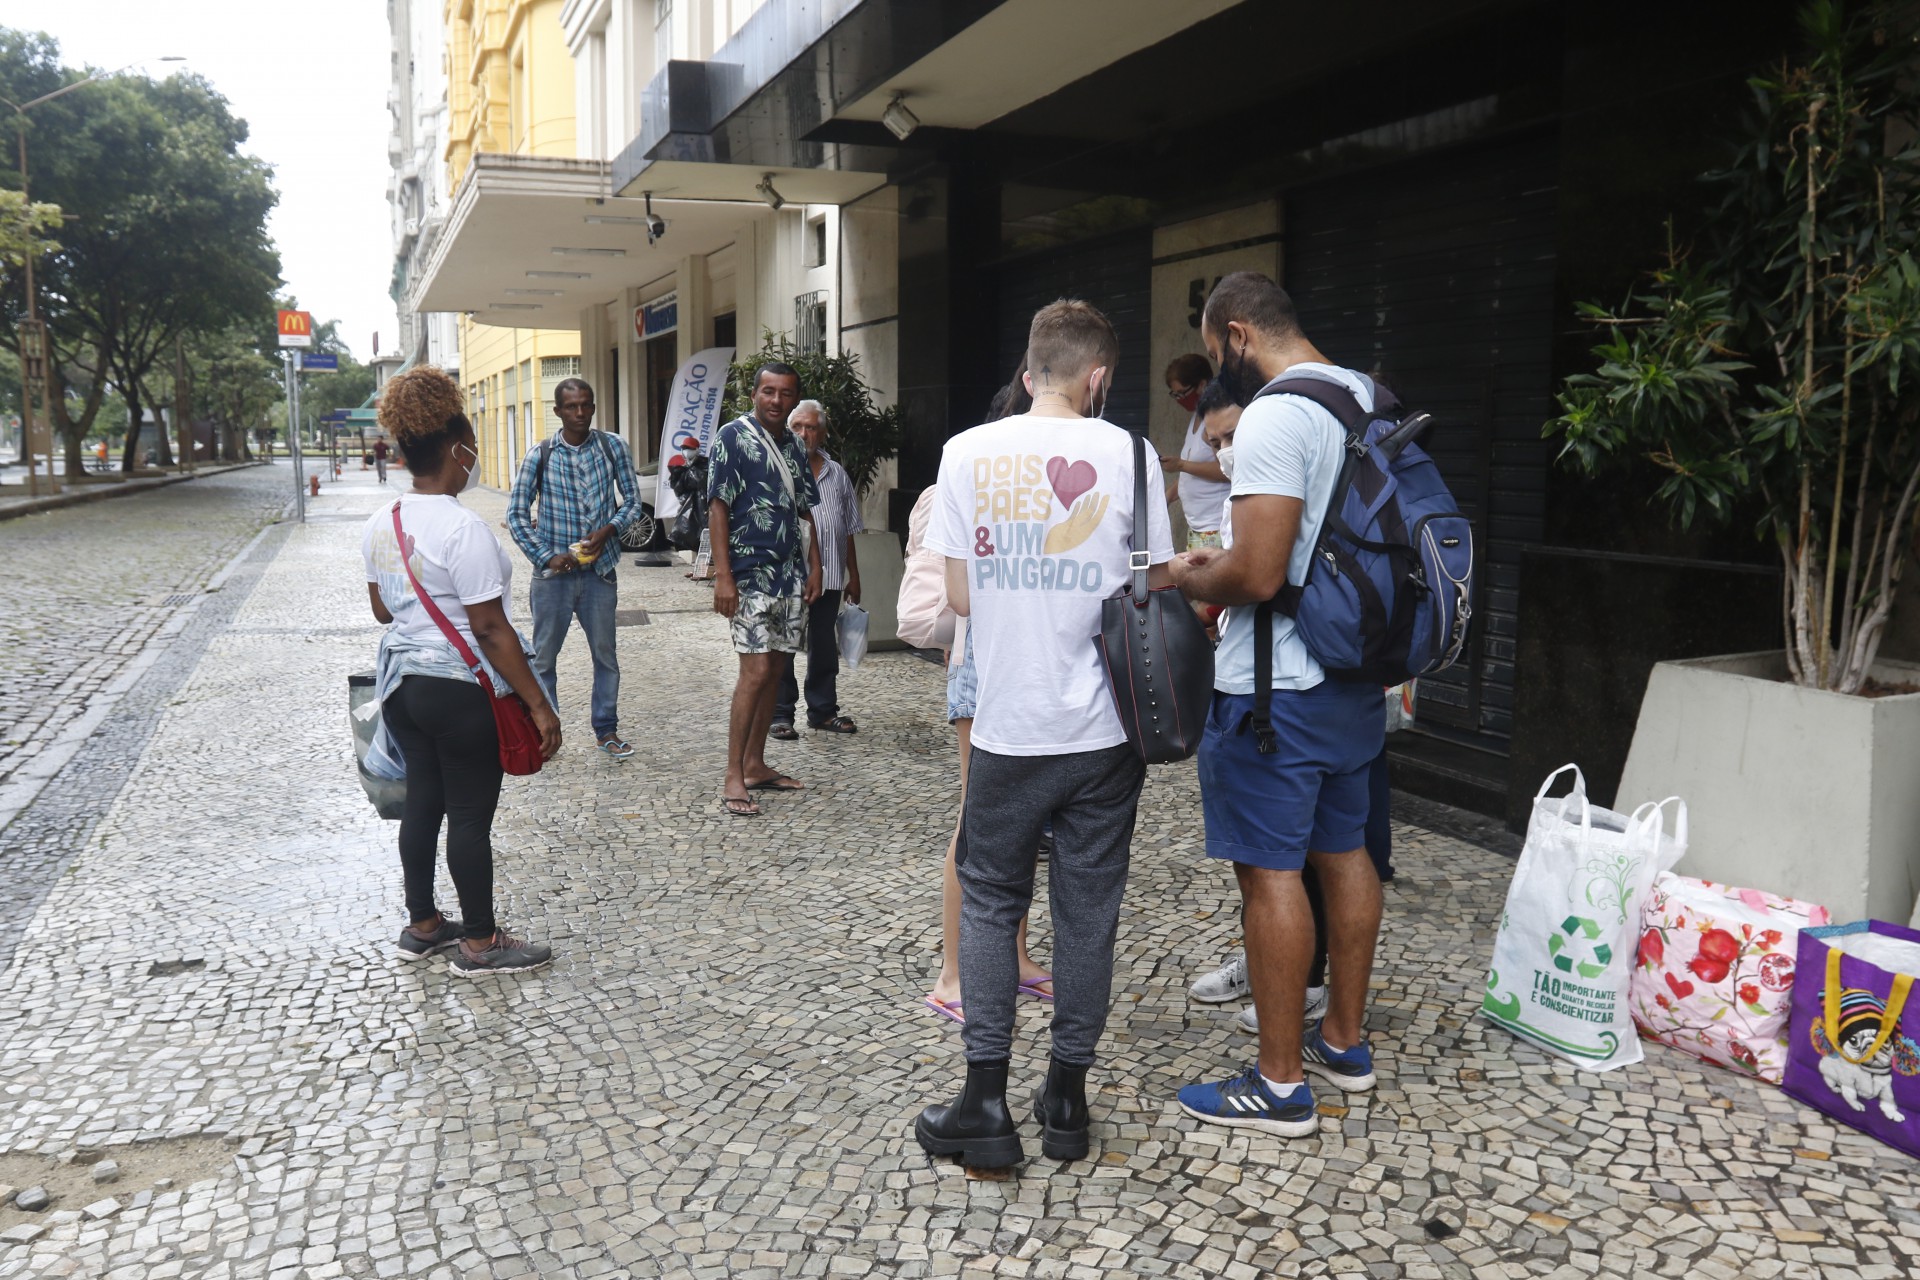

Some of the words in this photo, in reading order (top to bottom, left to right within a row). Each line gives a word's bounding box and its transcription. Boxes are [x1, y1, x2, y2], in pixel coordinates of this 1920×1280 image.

[671, 363, 708, 452] ORAÇÃO
[699, 387, 718, 441] 97470-6514
[973, 453, 1044, 490] DOIS
[973, 480, 1053, 526] PÃES
[974, 557, 1104, 594] PINGADO
[1534, 970, 1561, 997] TÃO
[1562, 981, 1616, 1000] IMPORTANTE
[1561, 994, 1584, 1005] QUANTO
[1586, 1000, 1615, 1010] RECICLAR
[1540, 994, 1614, 1023] CONSCIENTIZAR
